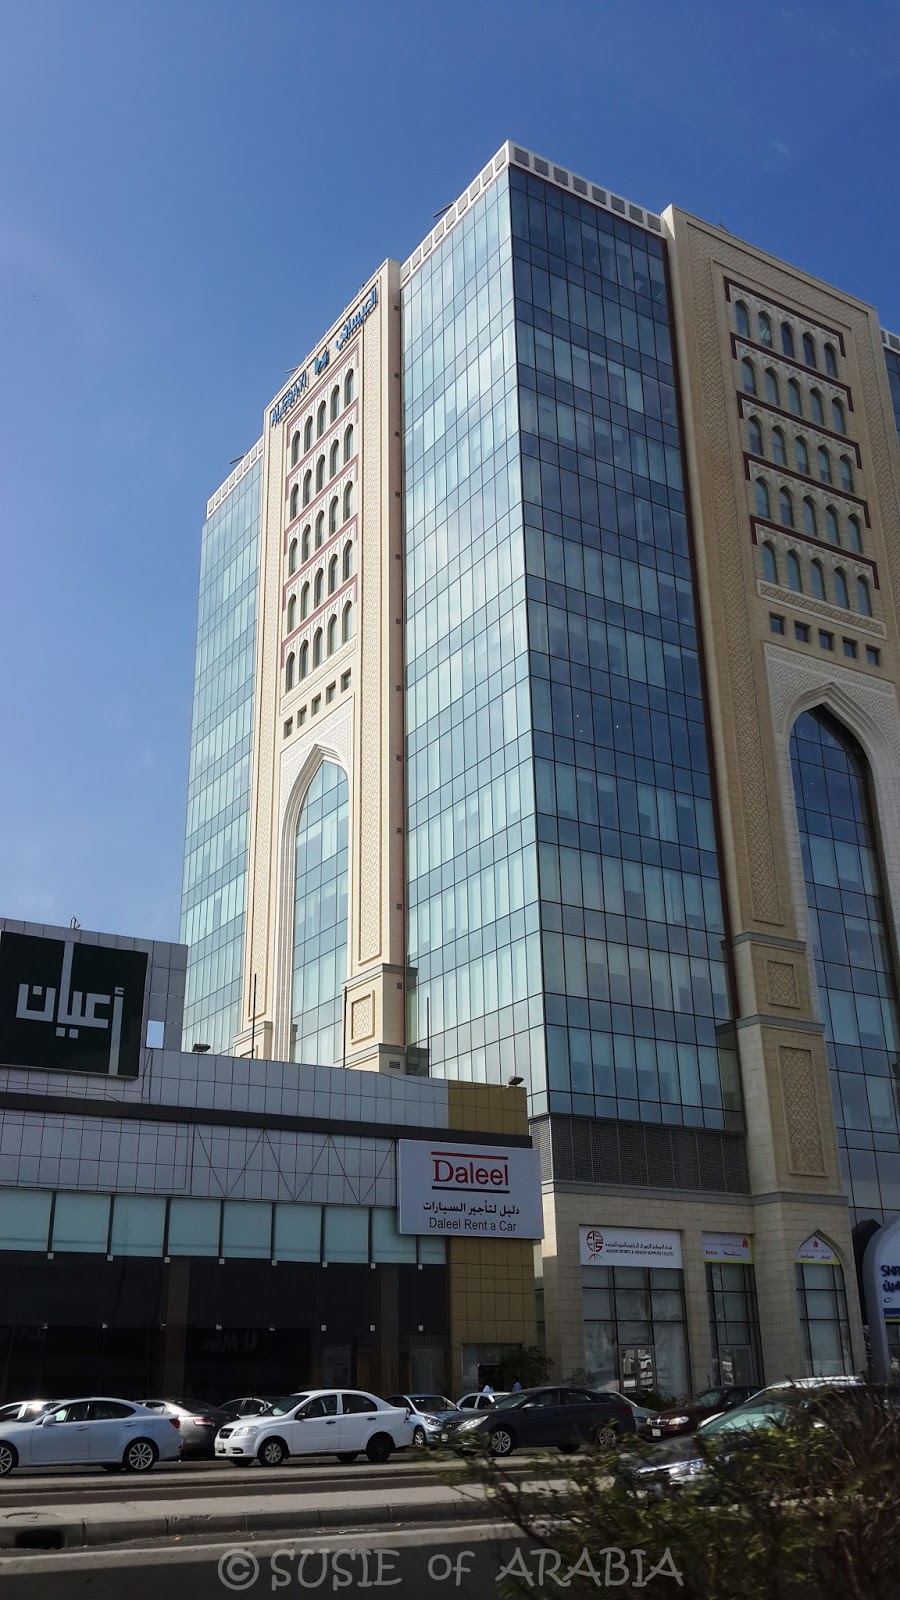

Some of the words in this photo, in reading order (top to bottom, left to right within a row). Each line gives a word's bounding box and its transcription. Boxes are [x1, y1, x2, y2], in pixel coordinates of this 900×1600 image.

[16, 941, 125, 1075] أعيان
[432, 1159, 509, 1186] Daleel
[422, 1202, 466, 1214] السيارات
[499, 1205, 520, 1217] دليل
[429, 1217, 461, 1230] Daleel
[464, 1219, 488, 1231] Rent
[499, 1221, 517, 1232] Car
